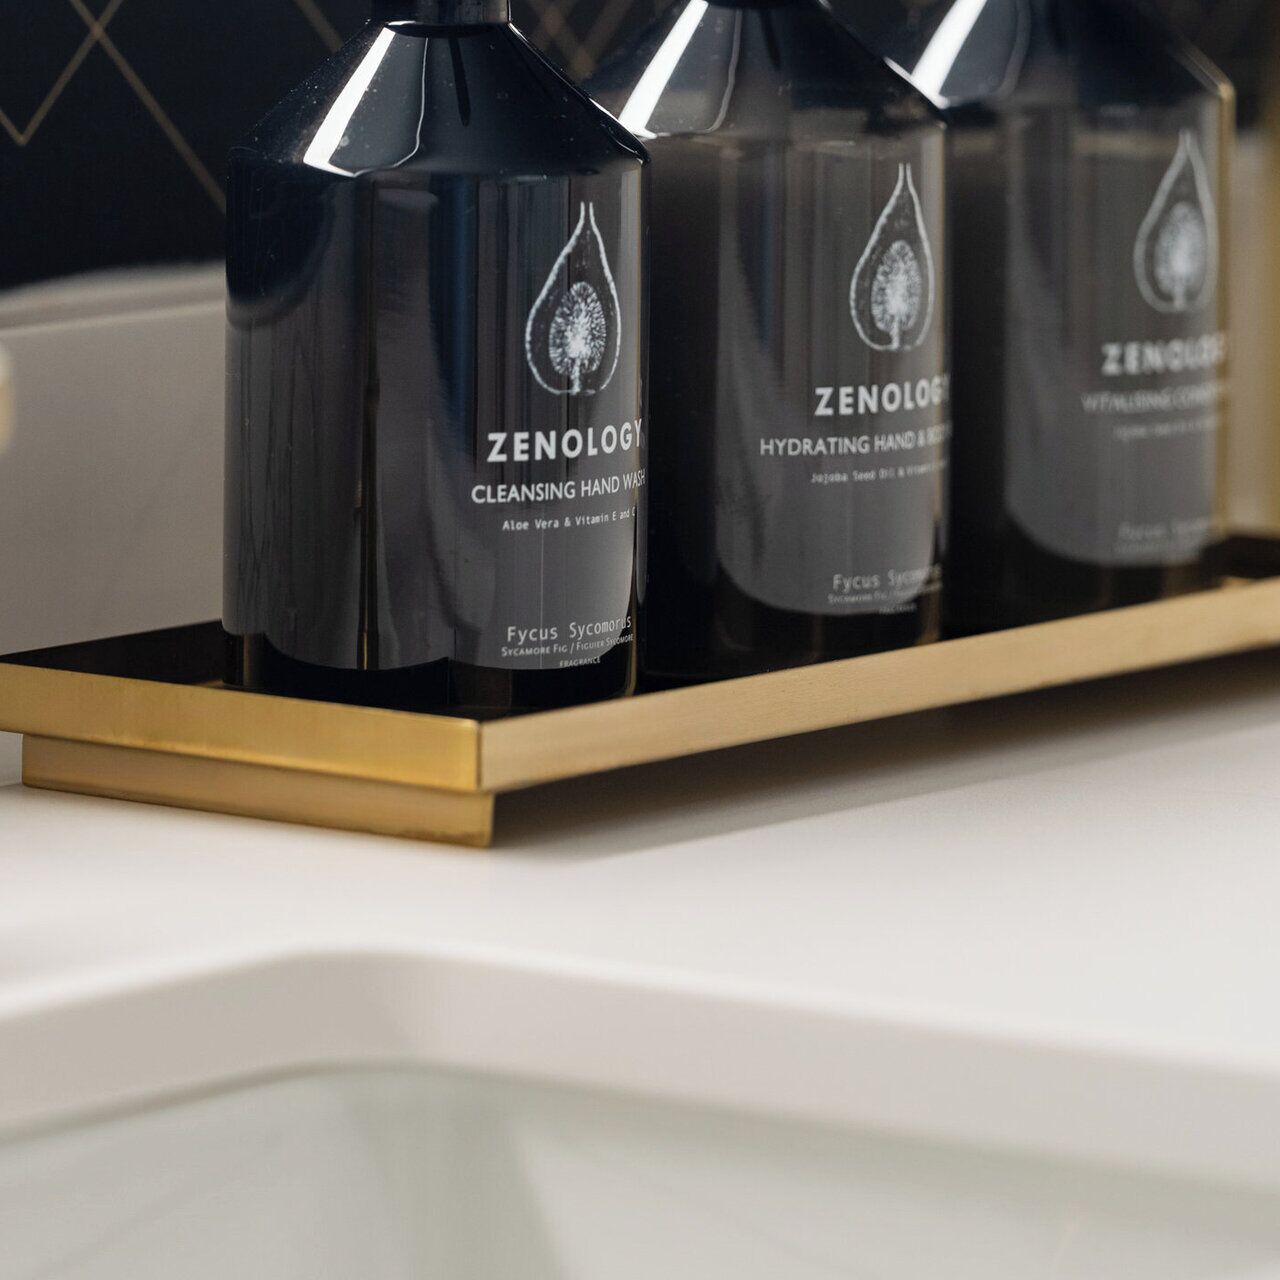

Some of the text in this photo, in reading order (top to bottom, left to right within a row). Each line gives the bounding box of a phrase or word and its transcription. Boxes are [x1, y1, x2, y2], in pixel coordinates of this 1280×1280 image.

[487, 418, 642, 462] ZENOLOGY
[760, 436, 870, 456] HYDRATING
[873, 430, 914, 452] HAND
[471, 468, 646, 504] CLEANSING HAND WASH
[502, 520, 529, 531] Aloe
[535, 518, 559, 530] Vera
[564, 516, 571, 527] &
[575, 513, 609, 526] Vitamin
[612, 511, 617, 520] E
[620, 509, 630, 520] and
[832, 573, 881, 594] Fycus
[507, 616, 631, 645] Fycus Sycomorus
